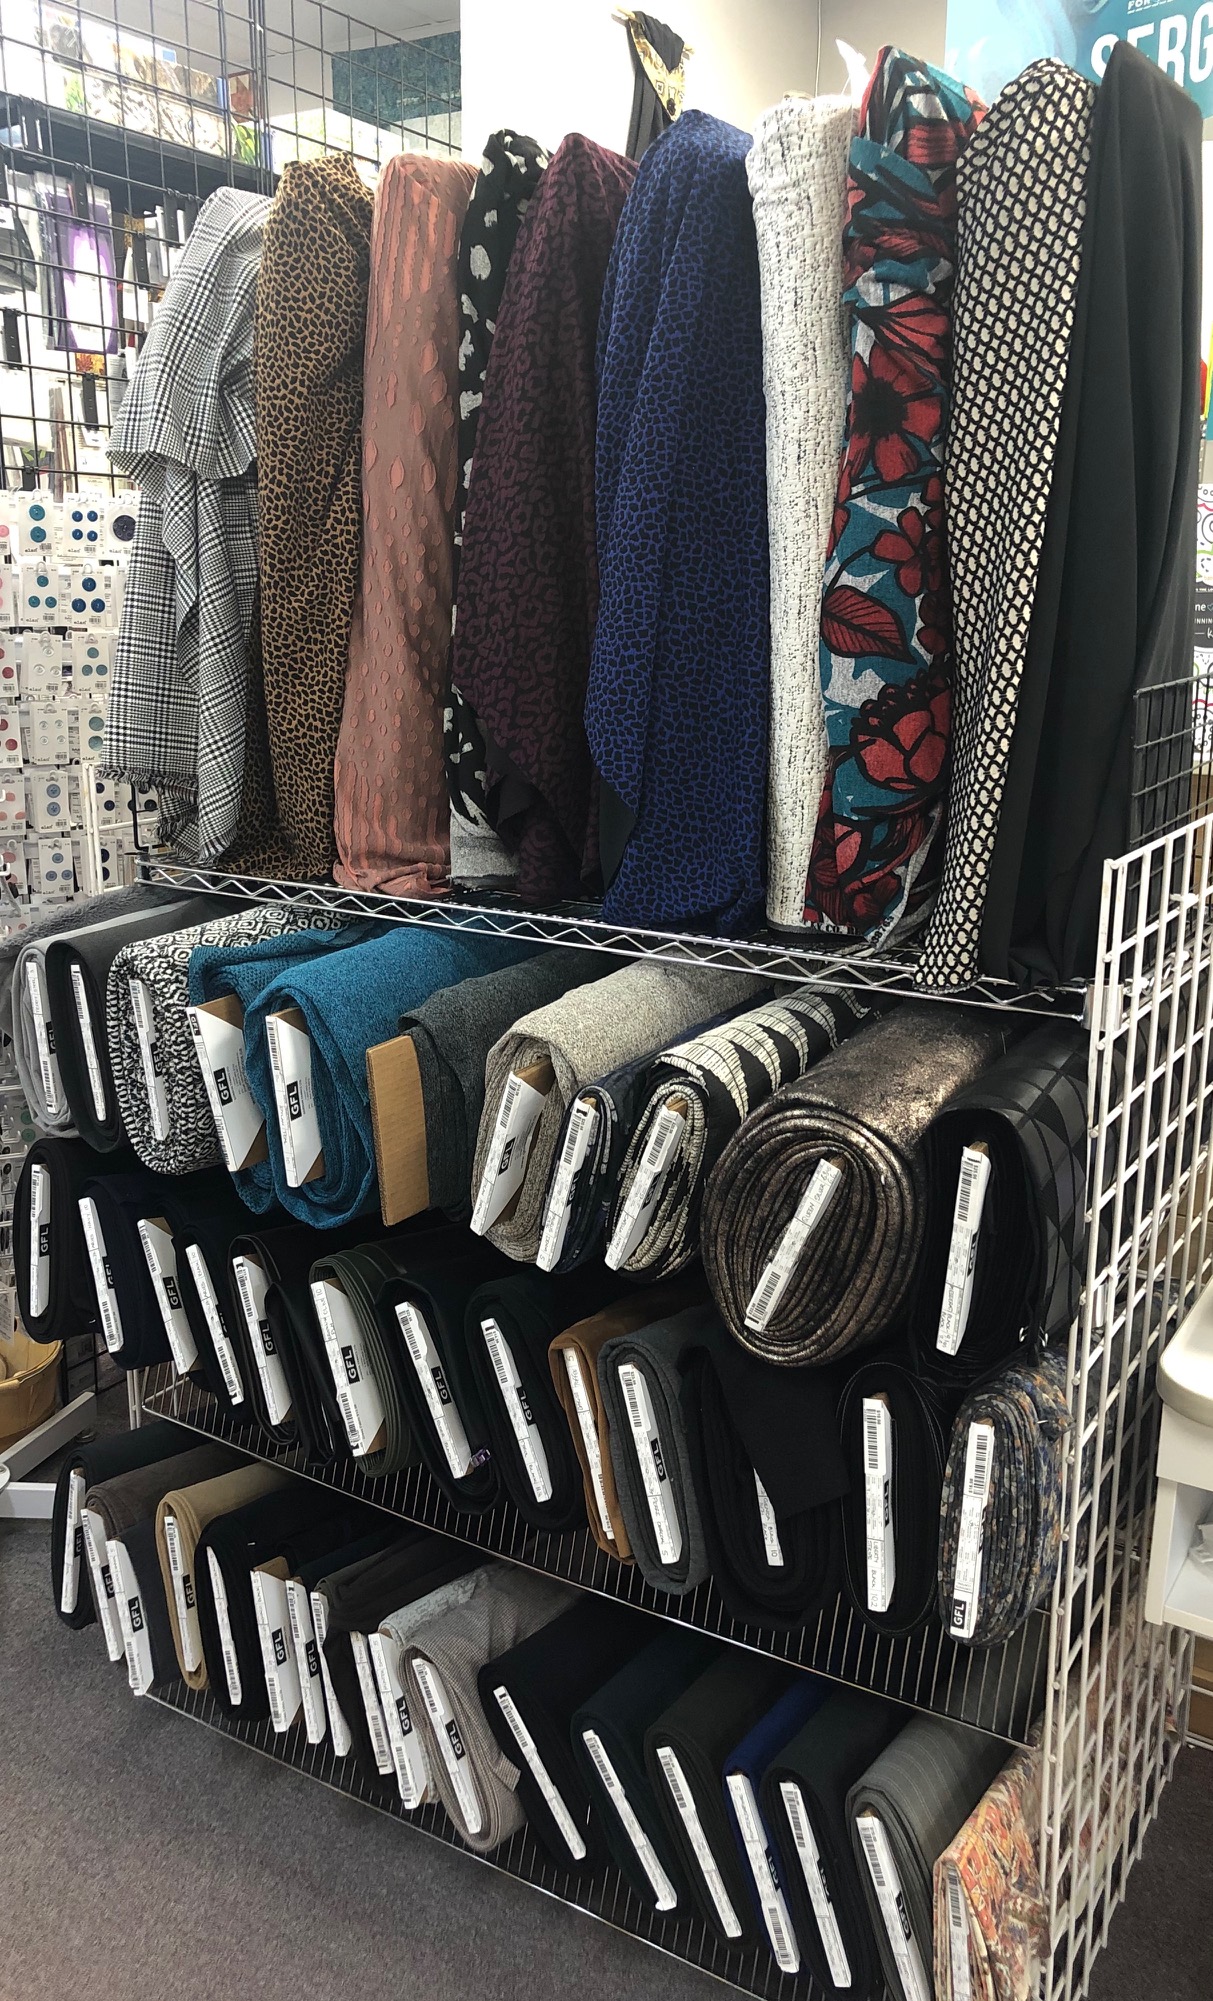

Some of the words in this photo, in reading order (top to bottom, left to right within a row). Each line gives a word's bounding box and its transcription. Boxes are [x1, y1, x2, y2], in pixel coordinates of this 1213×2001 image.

[217, 1072, 229, 1100] GFL
[289, 1086, 299, 1115] GFL
[501, 1141, 513, 1170] GFL
[801, 1202, 814, 1221] QUEEN
[40, 1227, 49, 1253] GFL
[166, 1280, 178, 1305] GFL
[262, 1323, 273, 1351] GFL
[344, 1350, 356, 1379] GFL
[435, 1371, 448, 1400] GFL
[520, 1390, 532, 1421] GFL
[653, 1443, 664, 1477] GFL
[131, 1600, 141, 1628] GFL
[953, 1603, 965, 1626] GFL
[275, 1632, 284, 1660] GFL
[306, 1644, 317, 1672] GFL
[399, 1700, 409, 1731] GFL
[450, 1723, 462, 1755] GFL
